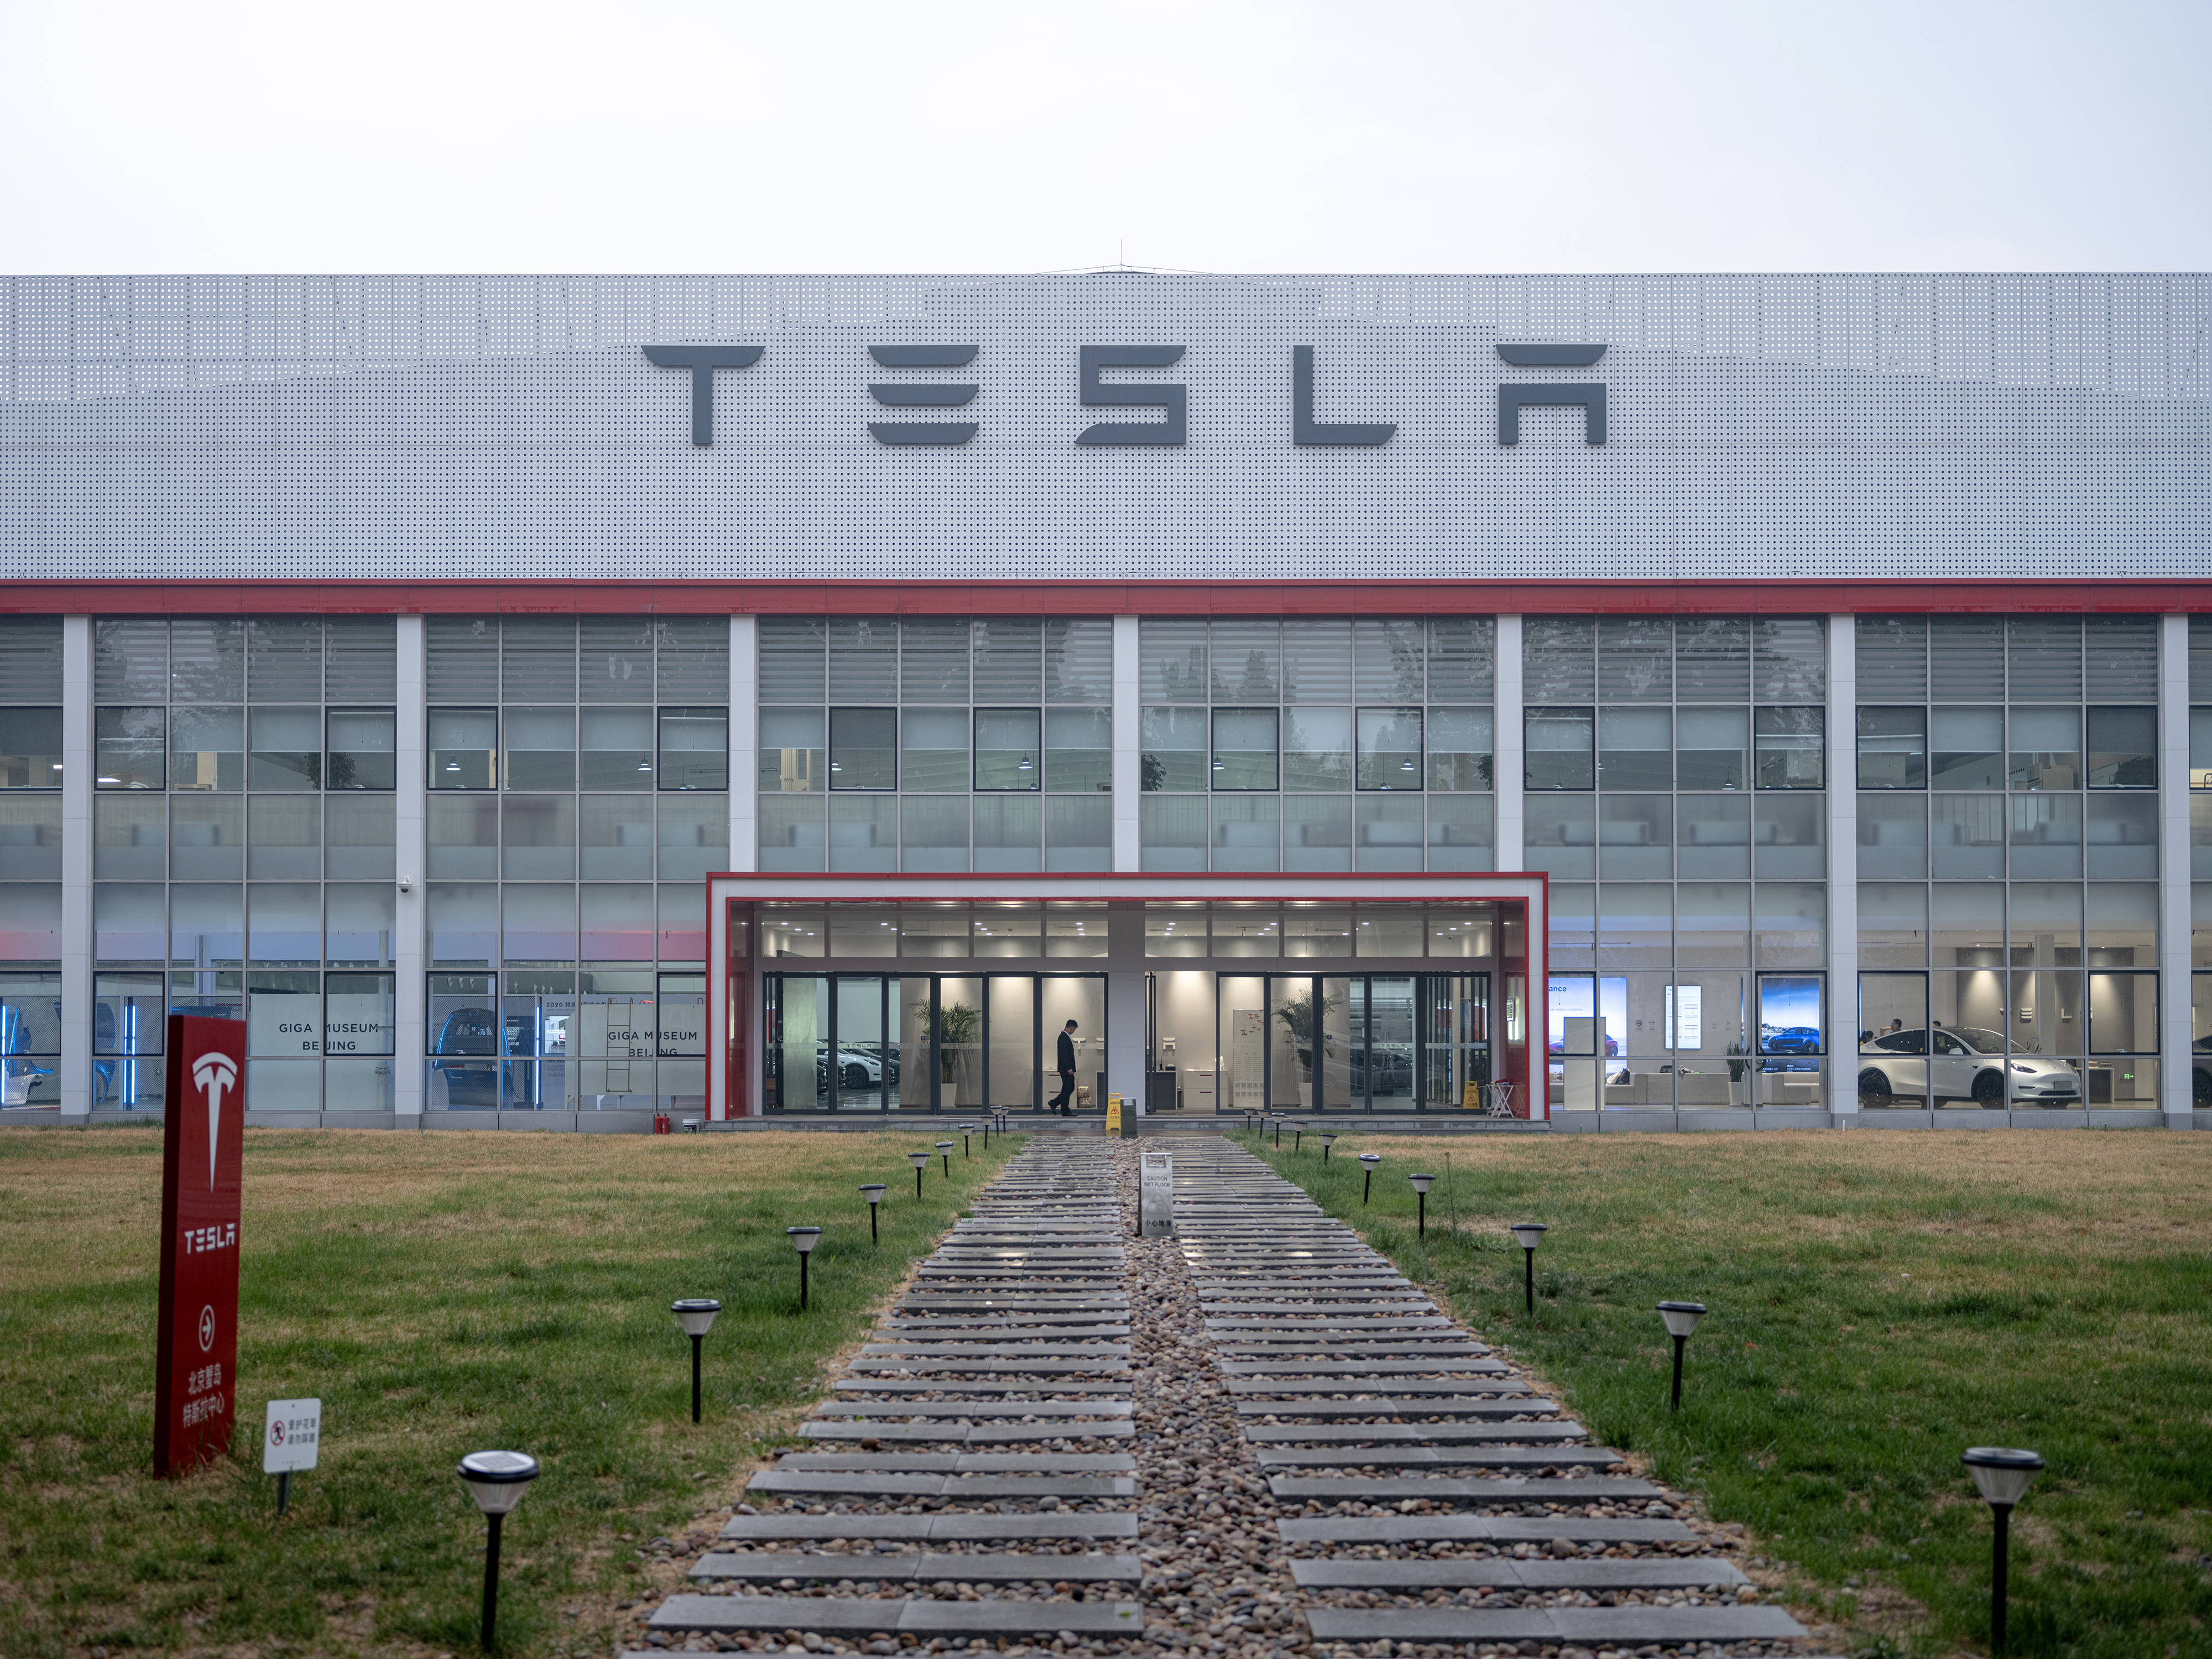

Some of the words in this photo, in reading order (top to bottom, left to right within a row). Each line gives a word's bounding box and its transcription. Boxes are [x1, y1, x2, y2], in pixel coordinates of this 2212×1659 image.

[640, 344, 1608, 444] TESLA
[279, 1023, 312, 1032] GIGA
[608, 1031, 639, 1040] GIGA
[302, 1041, 356, 1050] BEJING
[630, 1048, 677, 1057] BEIJNG
[1145, 1219, 1172, 1227] 小心地滑
[184, 1223, 235, 1254] TESLA
